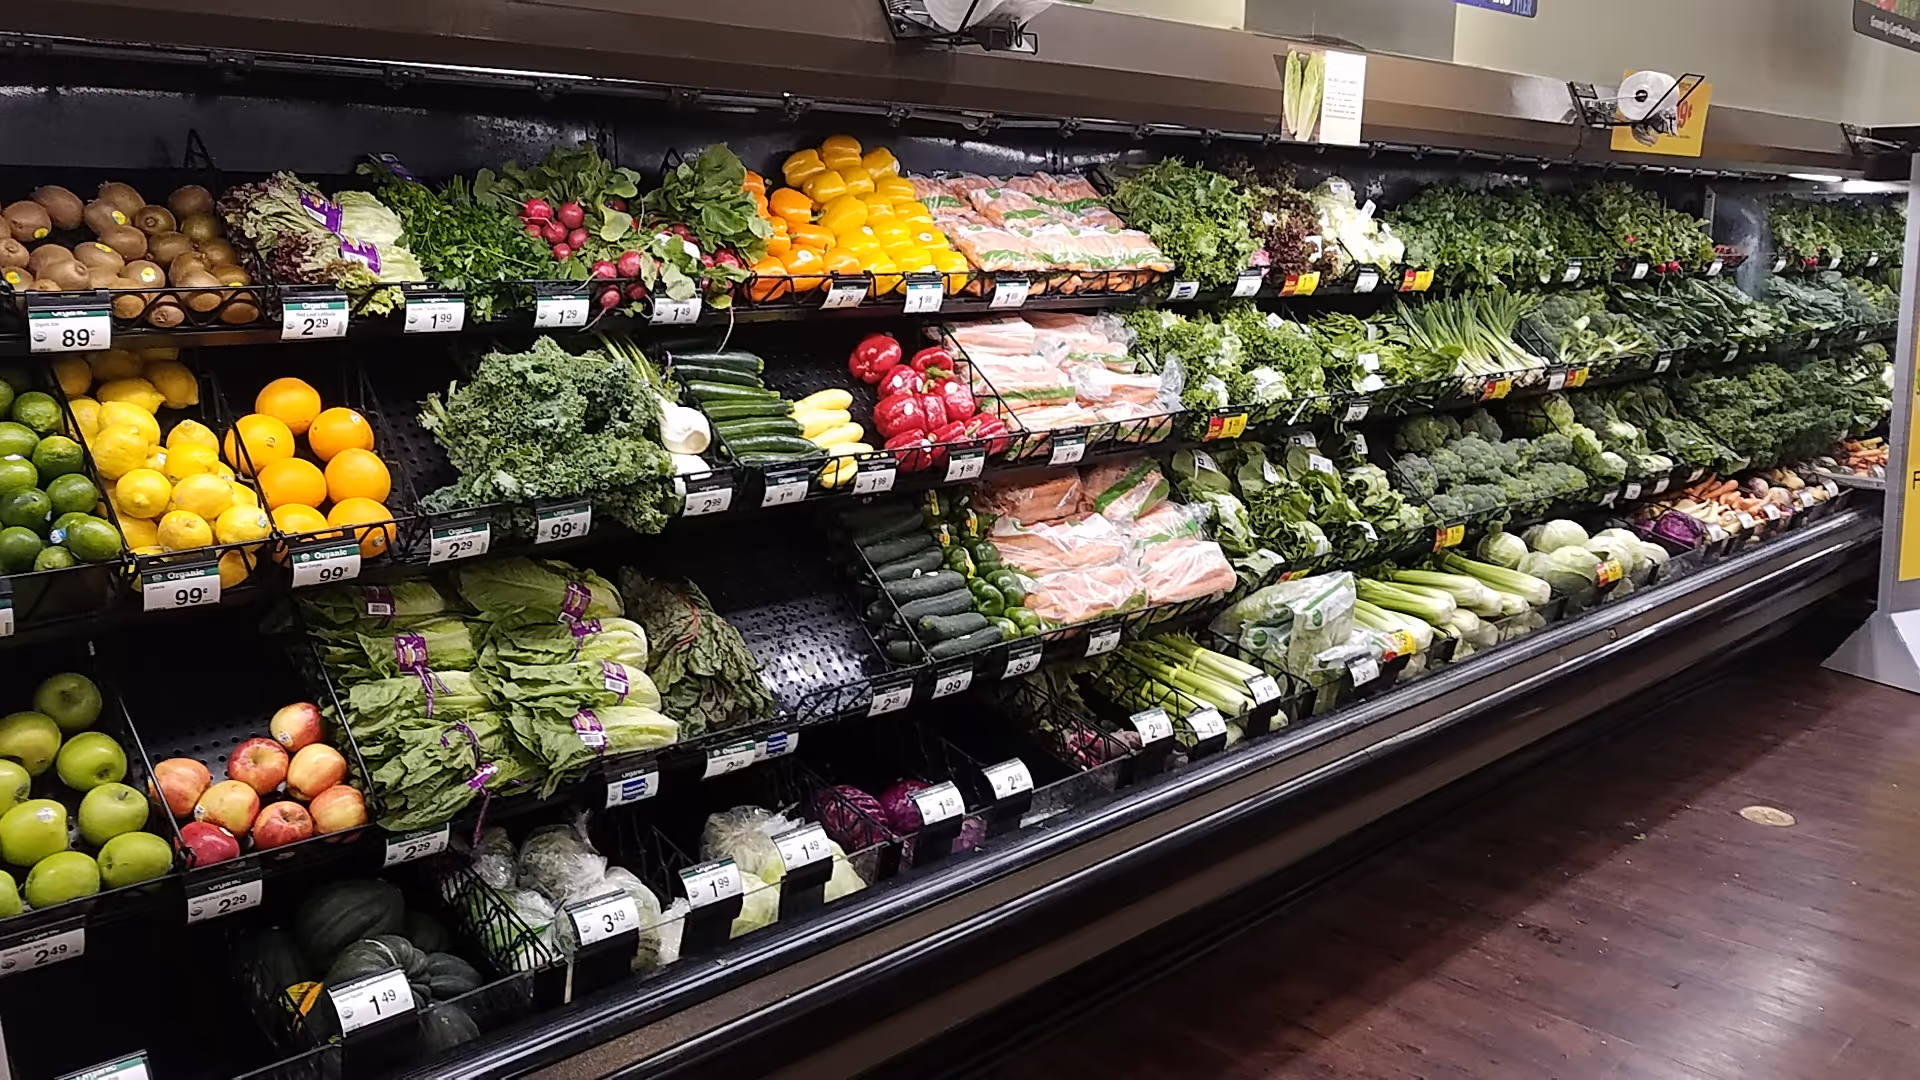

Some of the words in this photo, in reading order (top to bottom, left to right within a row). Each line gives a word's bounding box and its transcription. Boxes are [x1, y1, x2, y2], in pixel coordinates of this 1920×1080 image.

[301, 302, 329, 311] Organic
[313, 548, 348, 561] Organic
[167, 568, 206, 580] Organic
